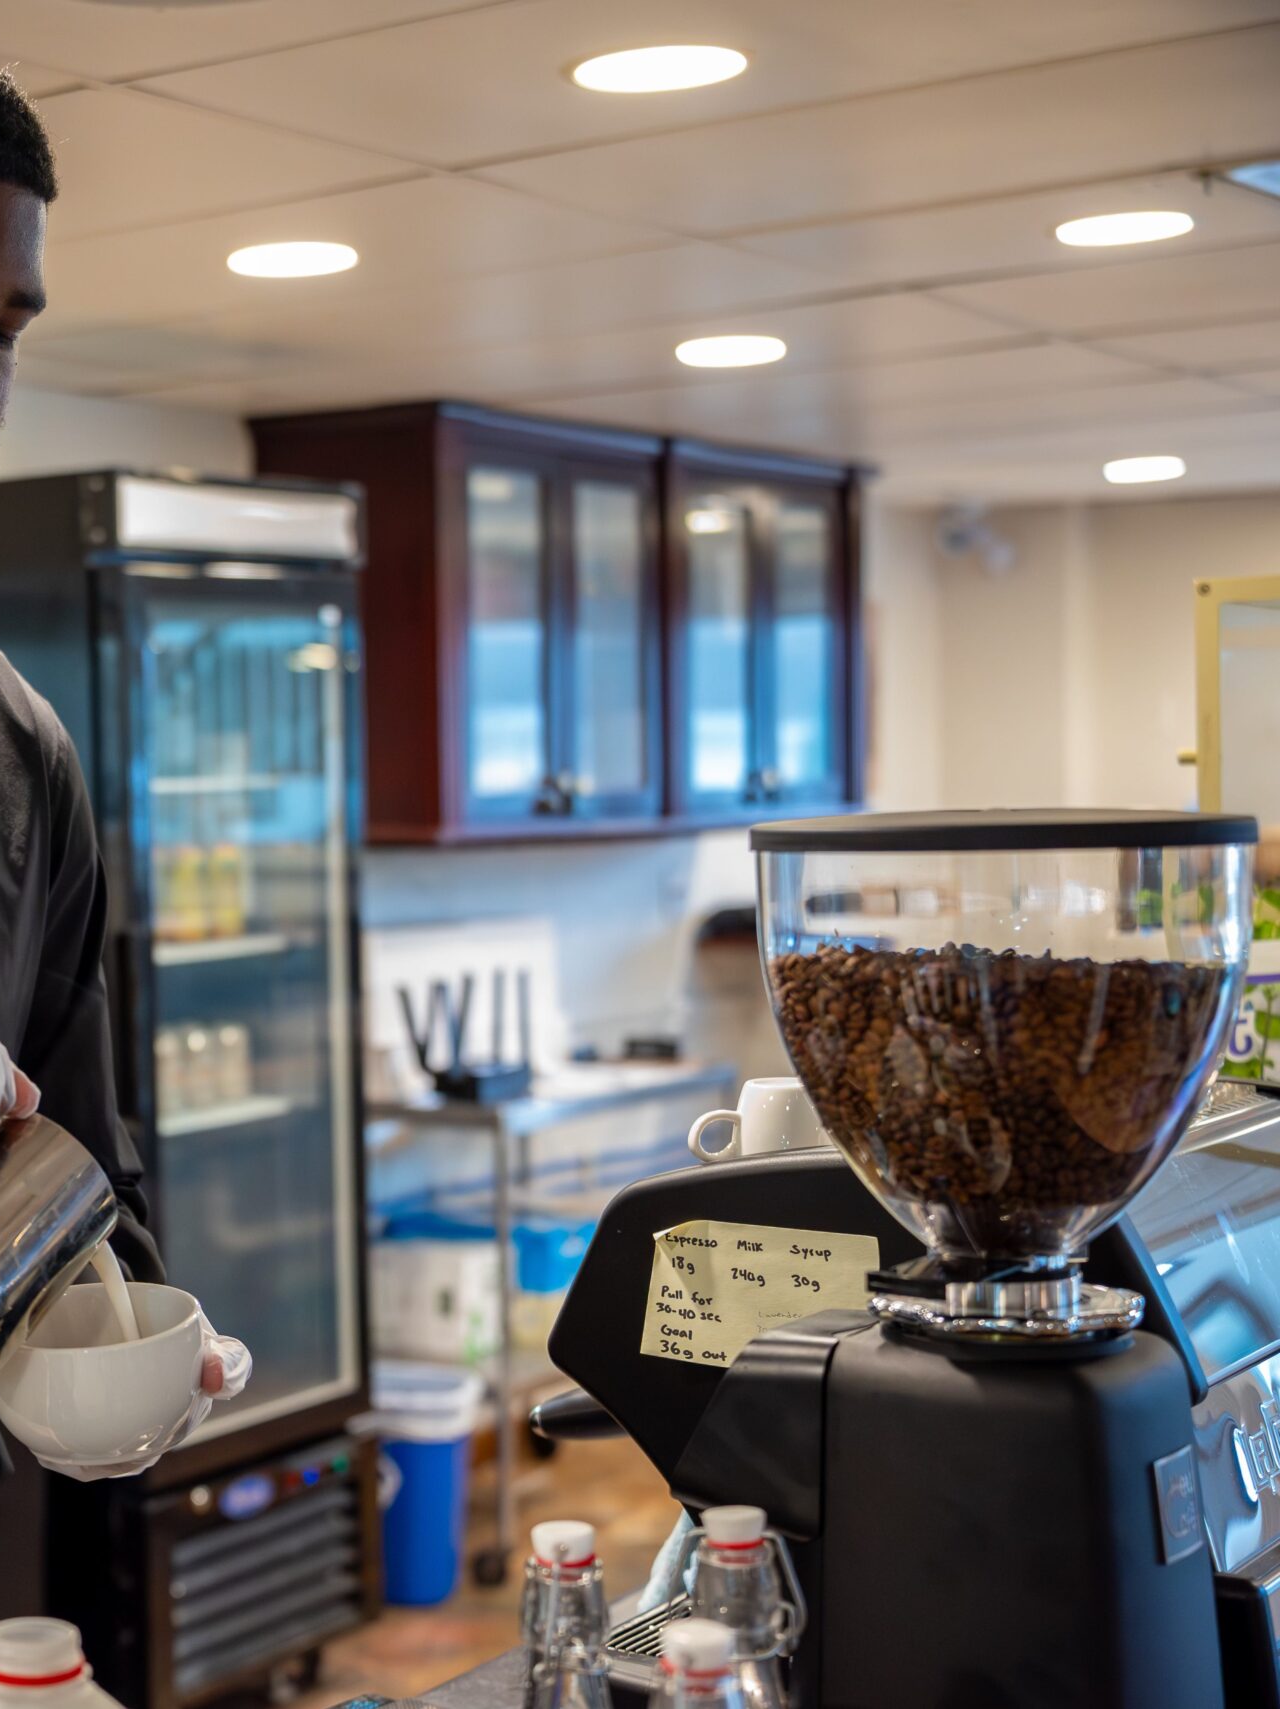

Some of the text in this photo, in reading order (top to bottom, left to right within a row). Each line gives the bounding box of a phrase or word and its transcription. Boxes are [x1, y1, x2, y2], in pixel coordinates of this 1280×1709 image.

[665, 1232, 718, 1248] Espresso
[789, 1244, 832, 1262] Syrup
[671, 1255, 821, 1293] 18g 240g 30g
[661, 1285, 713, 1306] Pull for
[656, 1302, 722, 1323] 30-40 sec
[660, 1324, 693, 1341] Goal
[660, 1340, 694, 1360] 36g
